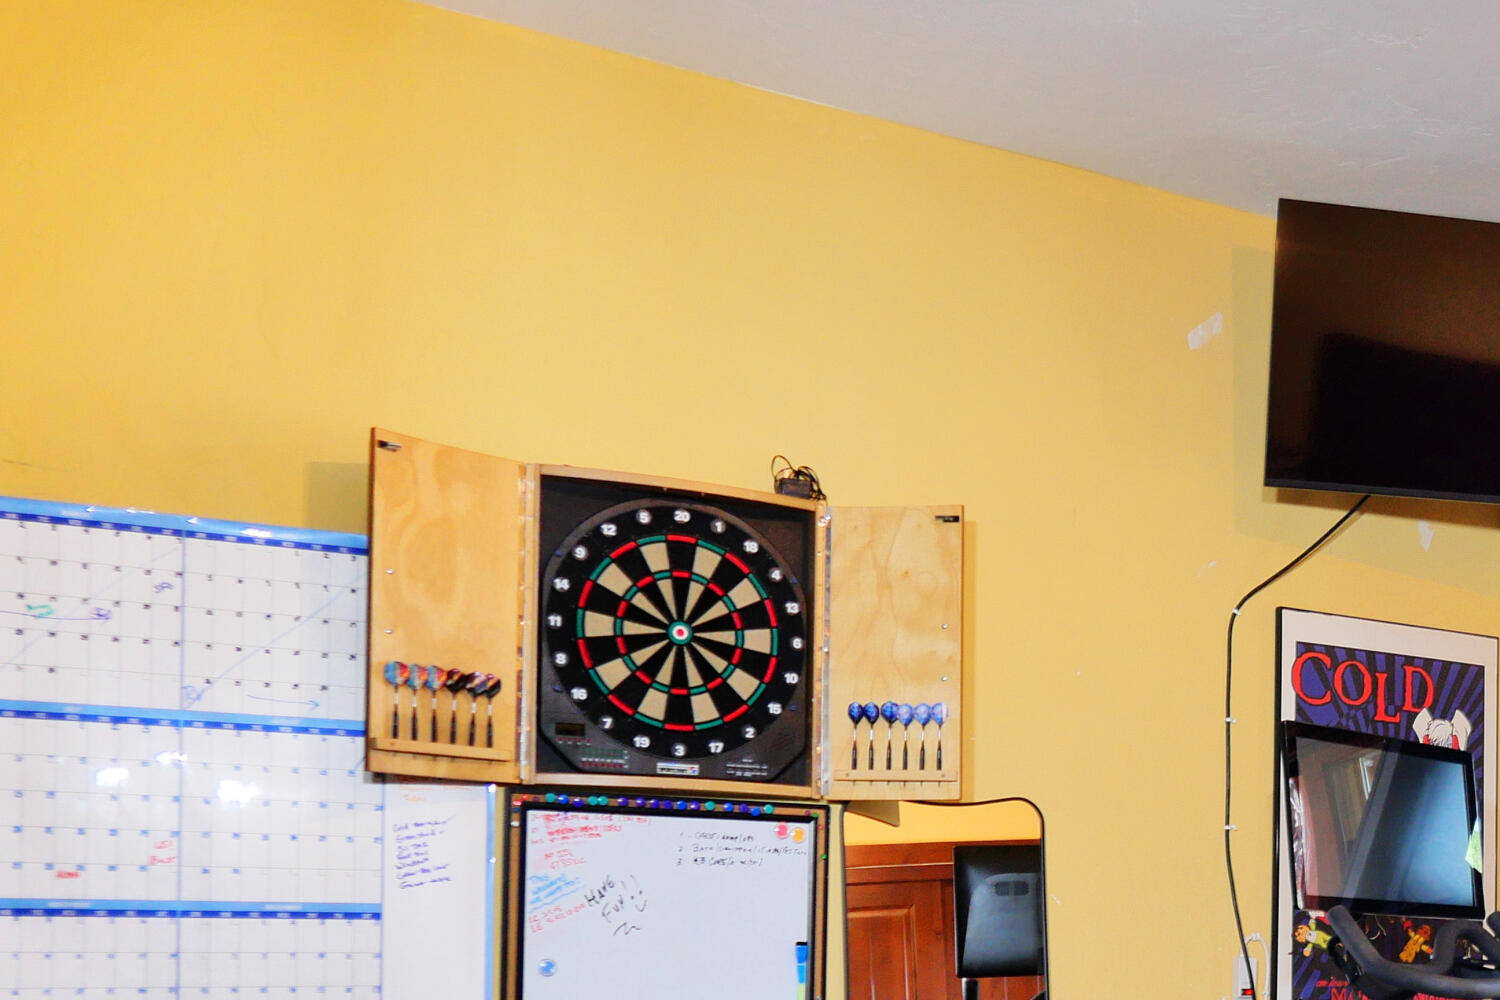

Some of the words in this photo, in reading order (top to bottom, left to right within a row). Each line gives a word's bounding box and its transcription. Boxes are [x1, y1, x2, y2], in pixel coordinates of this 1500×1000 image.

[639, 511, 650, 524] 5
[674, 510, 690, 522] 20
[601, 524, 617, 536] 12
[575, 546, 586, 559] 9
[743, 541, 759, 553] 18
[771, 569, 781, 581] 4
[554, 578, 570, 590] 14
[785, 602, 799, 614] 13
[548, 615, 562, 627] 11
[792, 638, 802, 649] 6
[555, 653, 567, 665] 8
[784, 673, 799, 684] 10
[1291, 651, 1435, 723] COLD
[571, 688, 587, 700] 16
[767, 703, 782, 715] 15
[602, 718, 613, 729] 7
[745, 727, 755, 739] 2
[633, 736, 650, 748] 19
[708, 742, 724, 753] 17
[674, 745, 685, 756] 3
